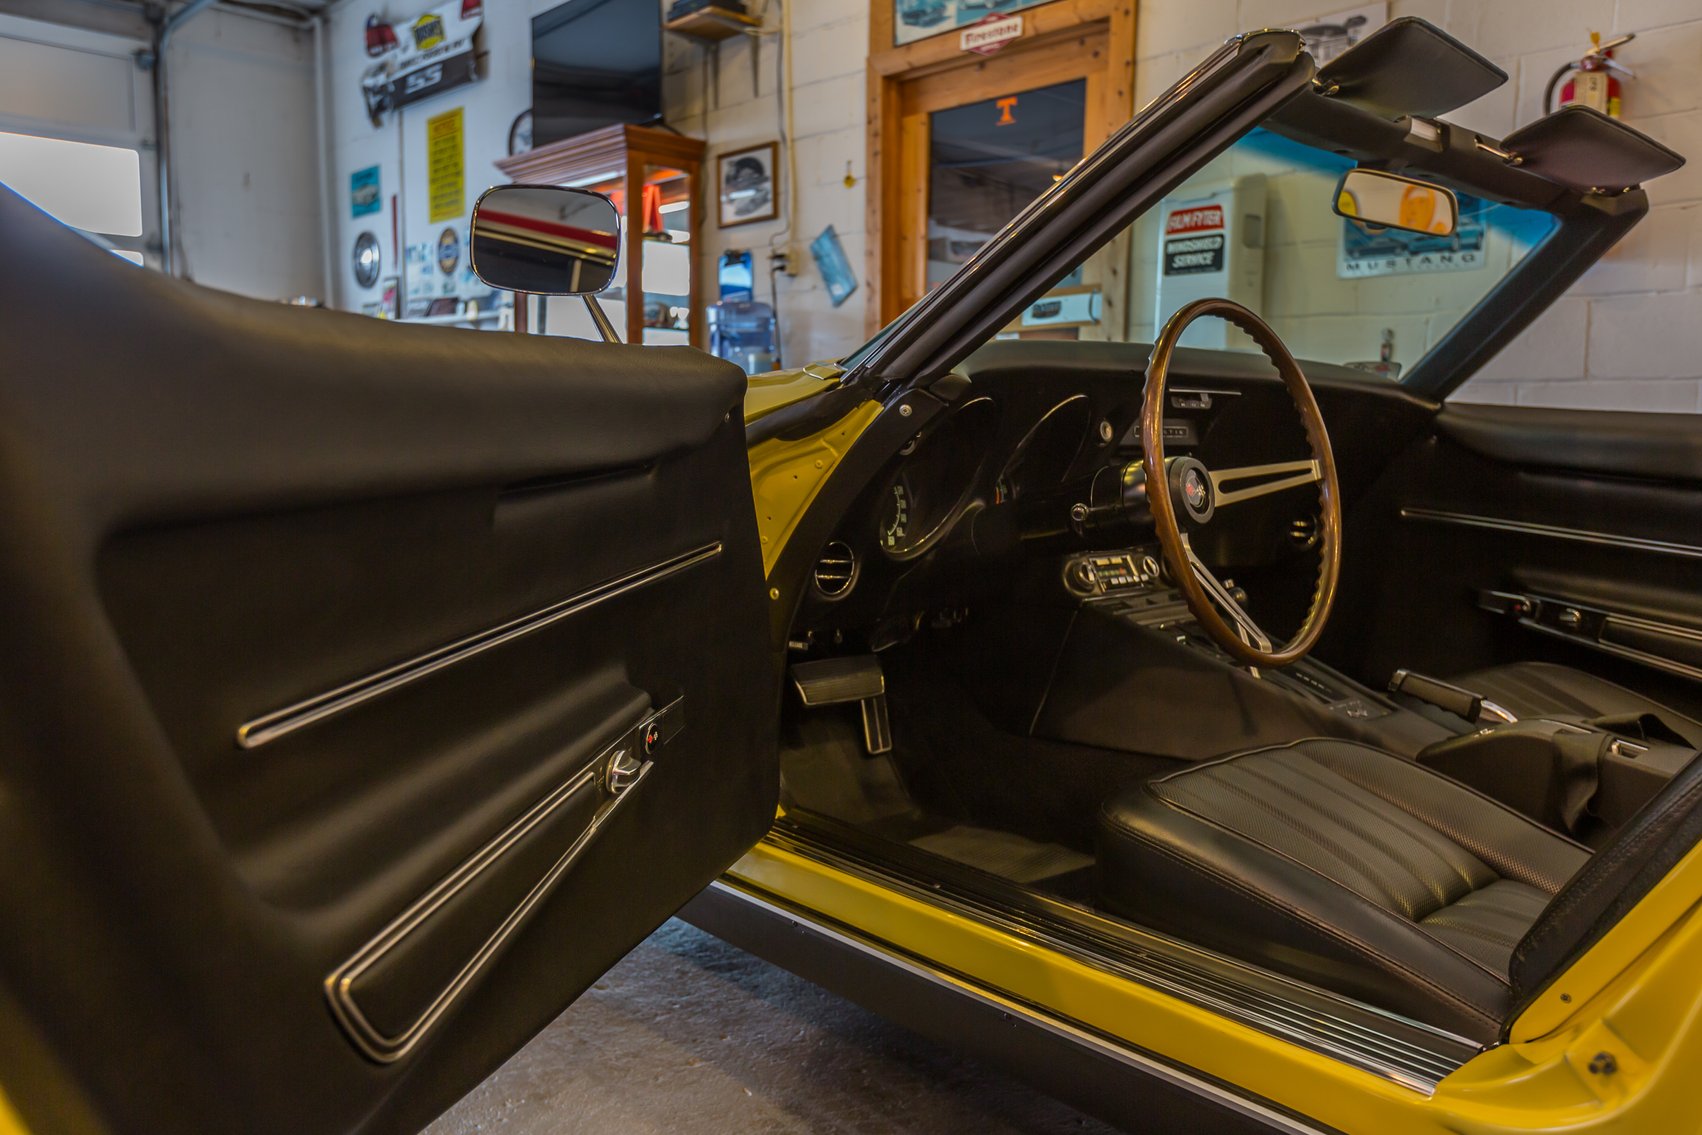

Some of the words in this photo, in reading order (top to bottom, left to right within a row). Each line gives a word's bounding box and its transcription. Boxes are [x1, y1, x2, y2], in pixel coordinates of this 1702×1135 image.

[965, 23, 1019, 45] Firestone
[996, 96, 1018, 126] T
[1172, 251, 1215, 268] SERVICE
[1346, 254, 1475, 271] MUSTANG
